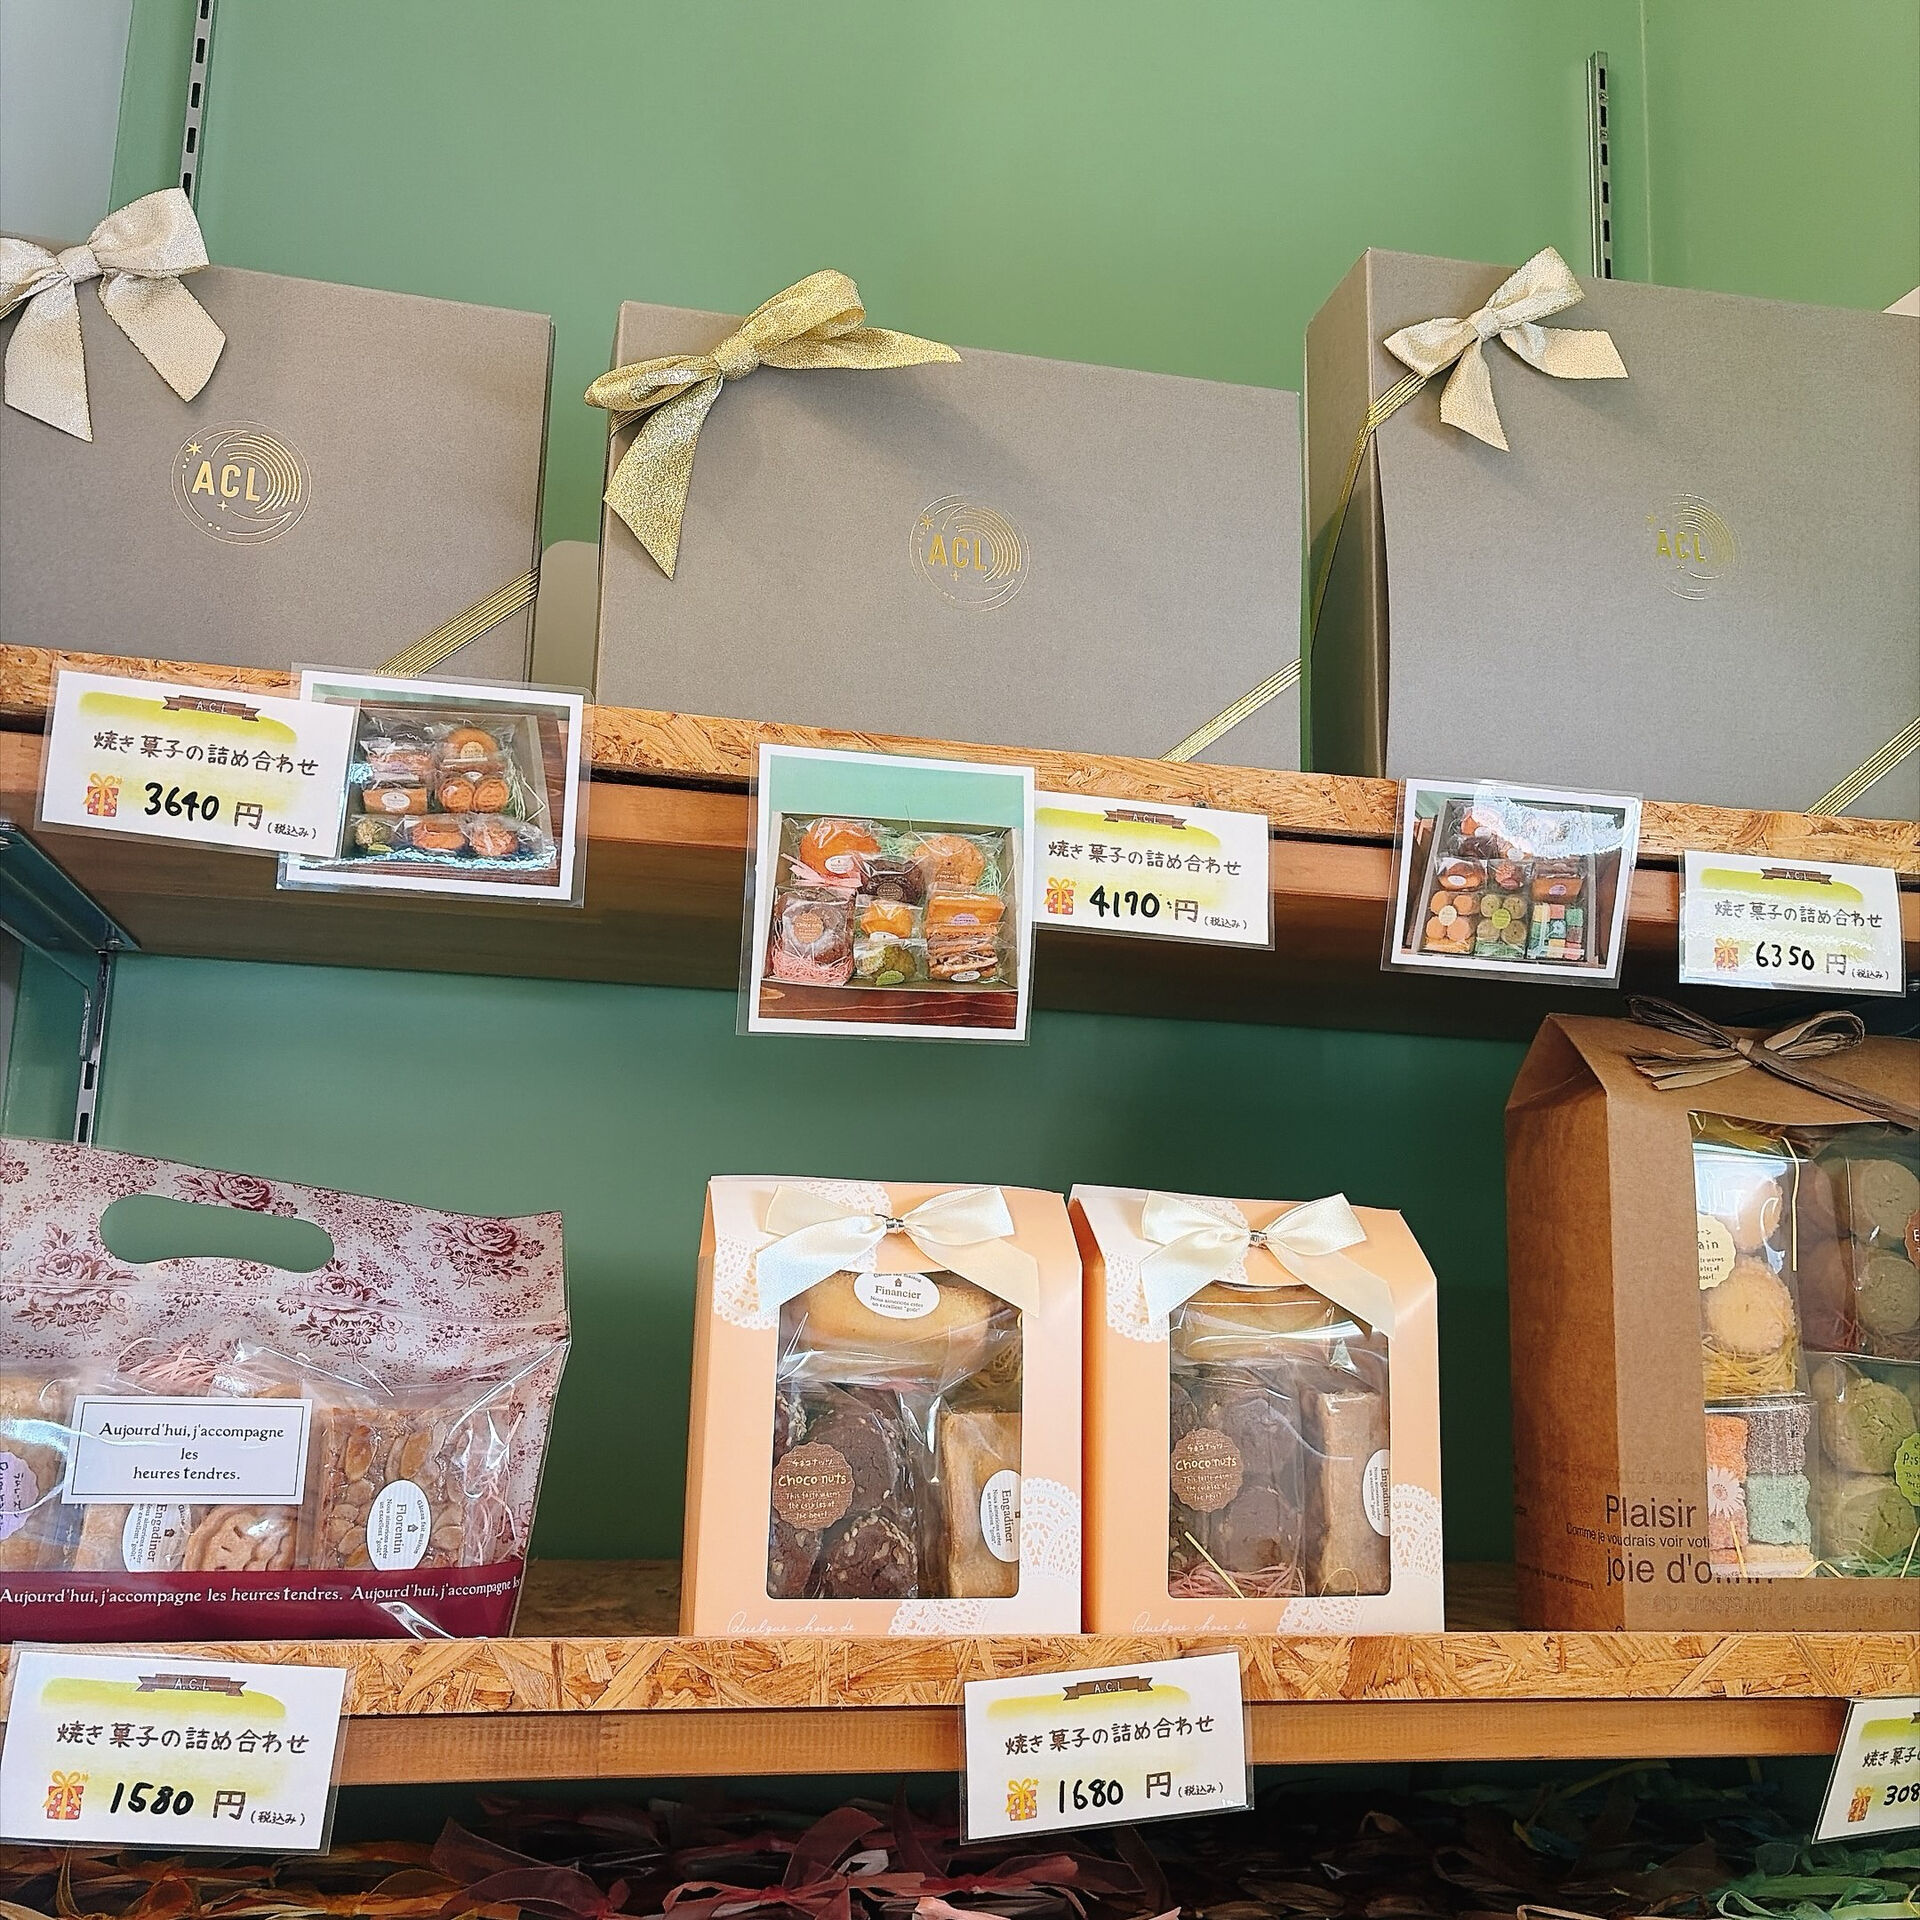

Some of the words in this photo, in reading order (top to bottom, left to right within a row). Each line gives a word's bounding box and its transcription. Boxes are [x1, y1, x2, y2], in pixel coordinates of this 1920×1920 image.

[191, 460, 260, 502] ACL
[928, 533, 987, 571] ACL
[1656, 529, 1707, 562] ACL
[93, 729, 320, 776] 焼き菓子の詰め合わせ
[144, 782, 219, 821] 3640
[234, 802, 263, 829] 円
[1048, 840, 1242, 876] 焼き菓子の詰め合わせ
[1089, 884, 1160, 918] 4170
[1174, 899, 1198, 923] 円
[1714, 900, 1883, 928] 焼き菓子の詰め合わせ
[1755, 941, 1815, 970] 6350
[1826, 953, 1846, 975] 円
[1697, 1239, 1719, 1250] ain
[875, 1285, 921, 1300] Financier
[99, 1422, 191, 1440] Aujourd'hui,
[191, 1423, 284, 1443] j'accompagne
[180, 1448, 198, 1461] les
[1903, 1452, 1920, 1465] Pis
[133, 1466, 180, 1480] heures
[183, 1466, 241, 1481] tendres.
[821, 1472, 847, 1485] nuts
[1000, 1489, 1014, 1543] Engadiner
[1605, 1494, 1697, 1528] Plaisir
[147, 1504, 168, 1563] Engadiner
[393, 1503, 407, 1554] Florentin
[1607, 1534, 1656, 1548] voudrais
[1659, 1535, 1683, 1548] voir
[1606, 1550, 1655, 1586] joie
[0, 1588, 98, 1607] Aujourd'hui,
[99, 1588, 201, 1607] j'accompagne
[207, 1588, 227, 1602] les
[231, 1587, 280, 1601] heures
[283, 1586, 343, 1601] tendres.
[351, 1584, 439, 1603] Aujourd'hui,
[440, 1579, 511, 1599] j'accompagne
[57, 1720, 310, 1754] 焼き菓子の詰め合わせ
[1005, 1715, 1215, 1756] 焼き菓子の詰め合わせ
[1862, 1746, 1920, 1768] 焼き菓子
[110, 1781, 194, 1816] 1580
[212, 1790, 246, 1820] 円
[1059, 1778, 1124, 1813] 1680
[1146, 1772, 1171, 1799] 円
